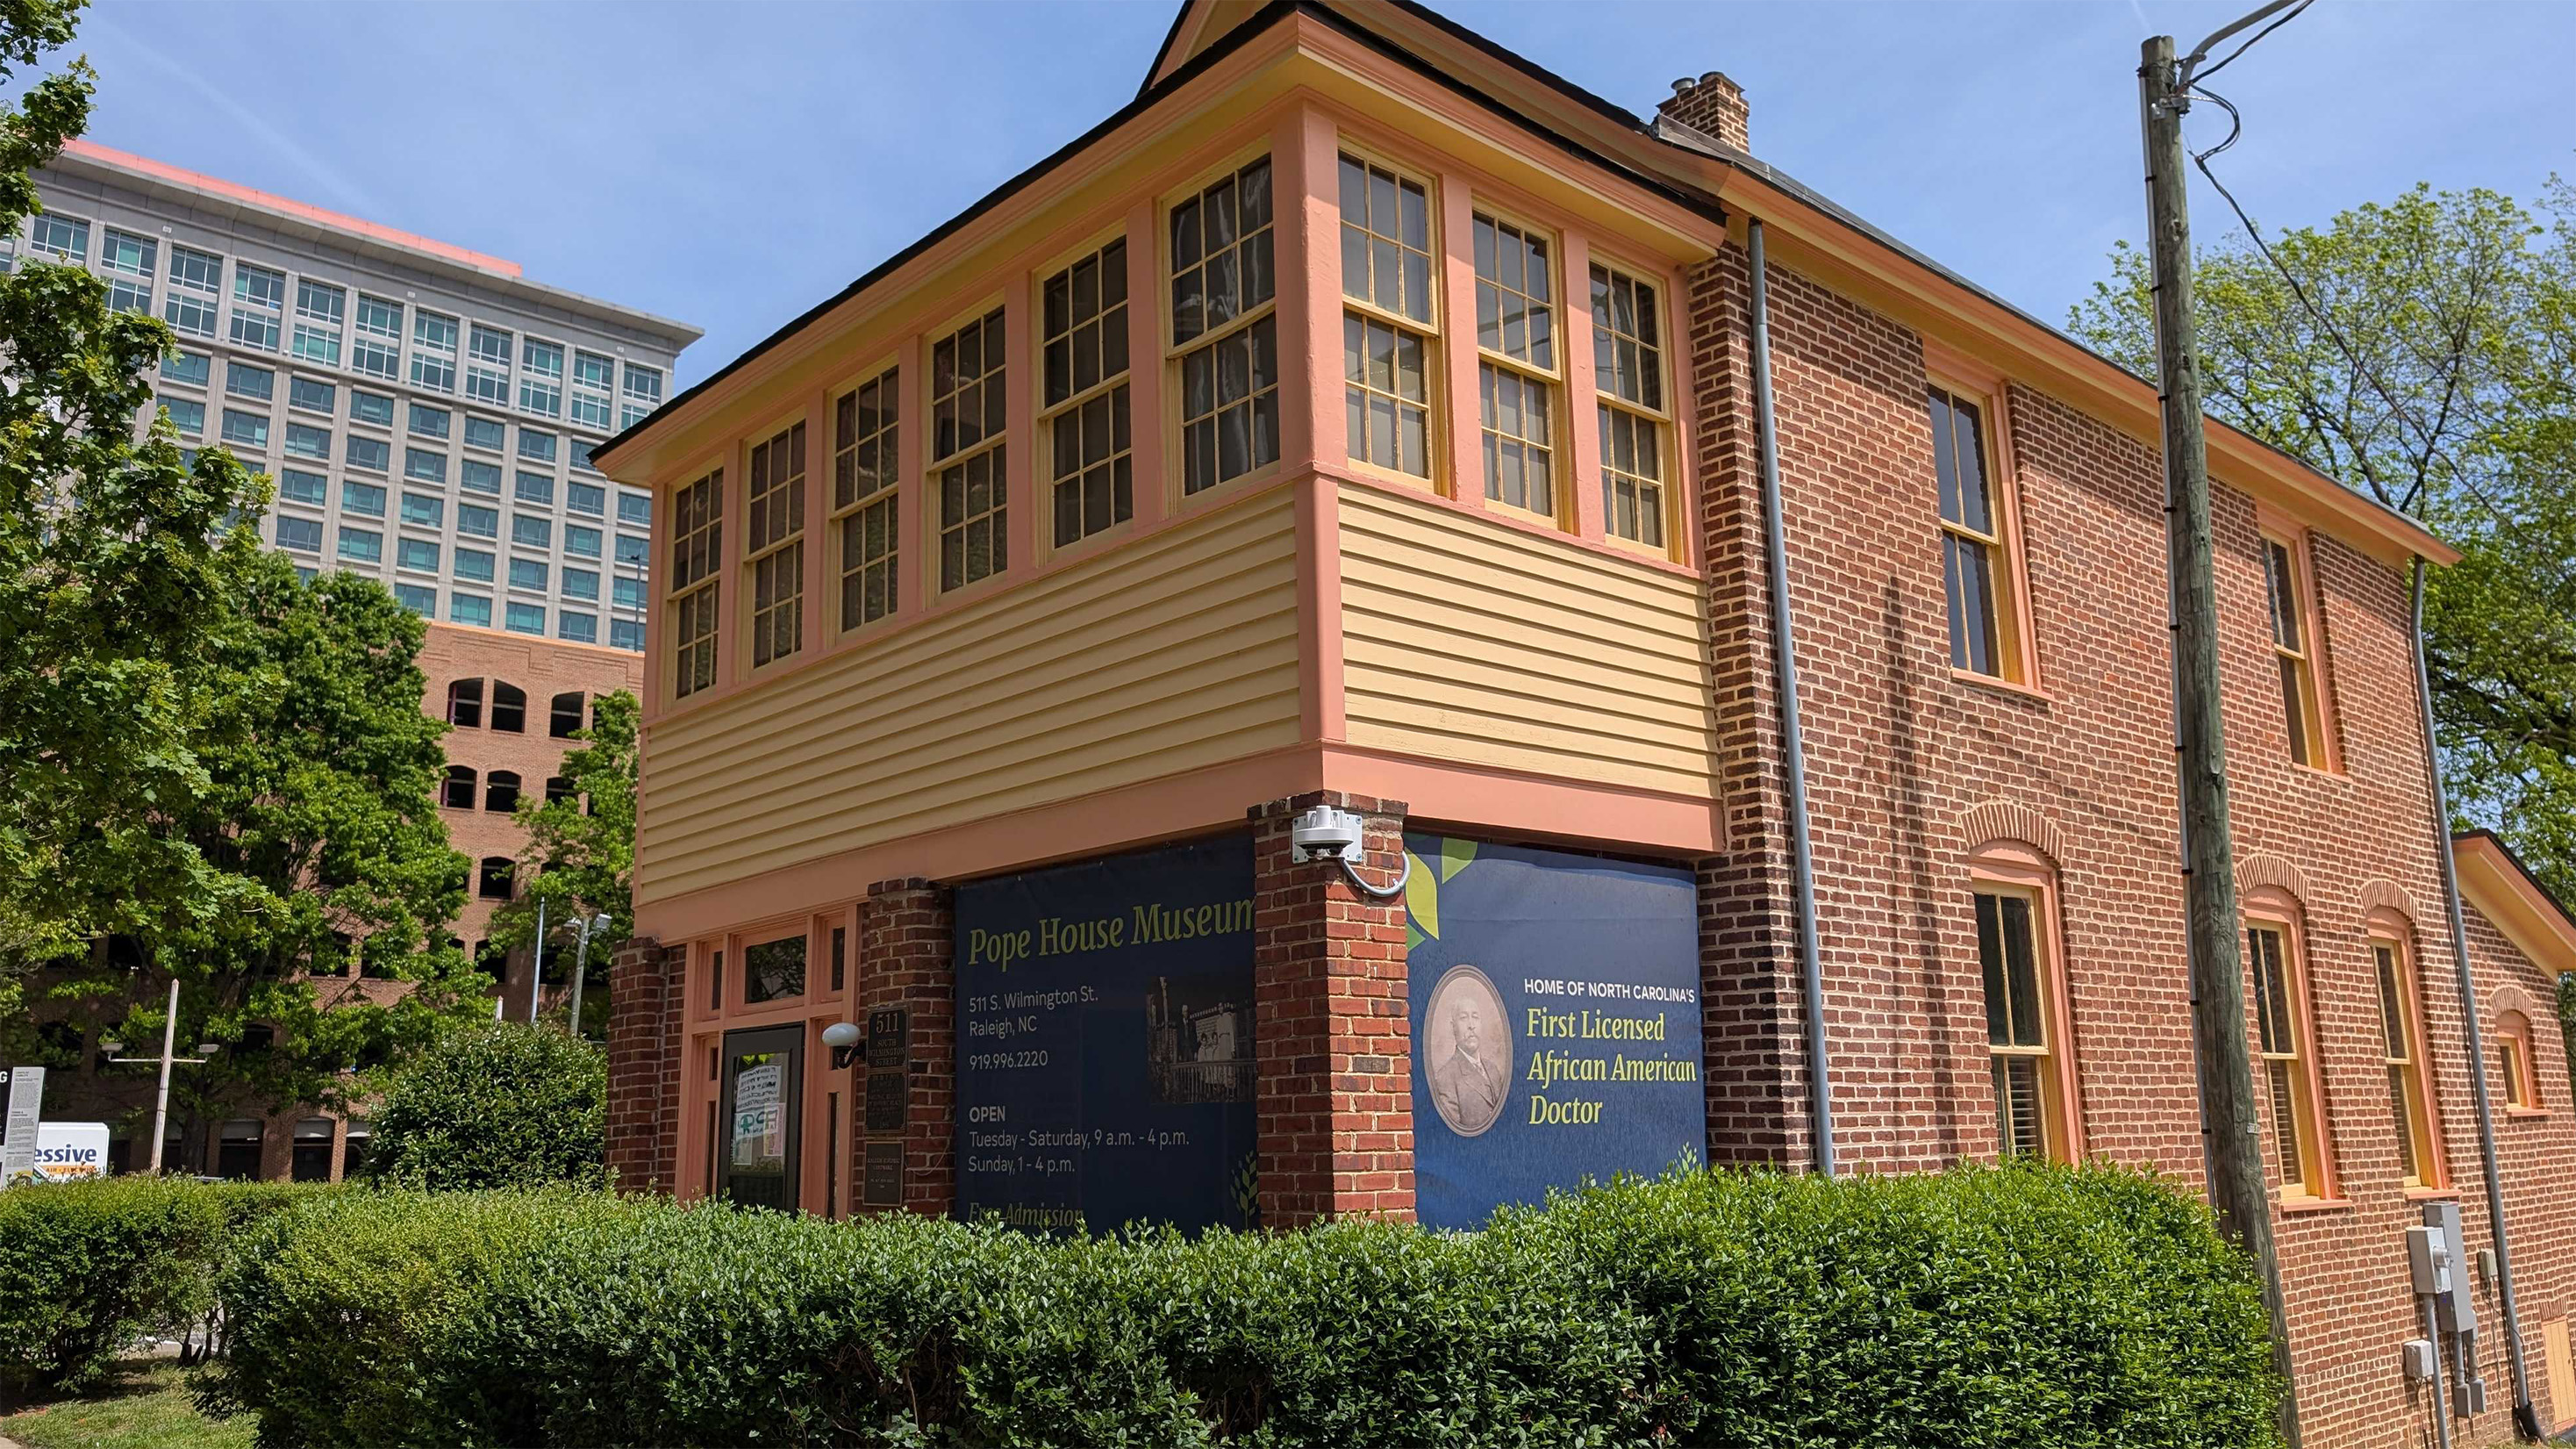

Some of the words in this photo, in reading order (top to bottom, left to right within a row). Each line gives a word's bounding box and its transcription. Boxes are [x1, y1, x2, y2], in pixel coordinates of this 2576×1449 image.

[968, 929, 1031, 972] Pope
[1039, 917, 1124, 957] House
[969, 996, 987, 1014] 511
[990, 993, 1001, 1011] S.
[1005, 988, 1077, 1011] Wilmington
[1080, 985, 1098, 1003] St.
[1524, 978, 1564, 996] HOME
[1567, 980, 1585, 997] OF
[1588, 982, 1630, 1000] NORTH
[1634, 985, 1695, 1003] CAROLINA'S
[877, 1012, 899, 1033] 511
[970, 1018, 1015, 1039] Raleigh,
[1019, 1015, 1037, 1033] NC
[1527, 1008, 1576, 1038] First
[1581, 1009, 1665, 1042] Licensed
[970, 1051, 1048, 1070] 919.996.2220
[1527, 1051, 1606, 1089] African
[1611, 1053, 1697, 1082] American
[969, 1105, 1006, 1123] OPEN
[1528, 1094, 1603, 1125] Doctor
[970, 1130, 1019, 1150] Tuesday
[1028, 1130, 1091, 1150] Saturday,
[1094, 1130, 1102, 1145] 9
[1106, 1130, 1135, 1146] a.m.
[1148, 1130, 1156, 1145] 4
[1160, 1130, 1190, 1151] p.m.
[969, 1157, 1015, 1176] Sunday,
[1018, 1157, 1022, 1172] 1
[1035, 1157, 1044, 1172] 4
[1048, 1158, 1076, 1177] p.m.
[1005, 1202, 1084, 1227] Admission
